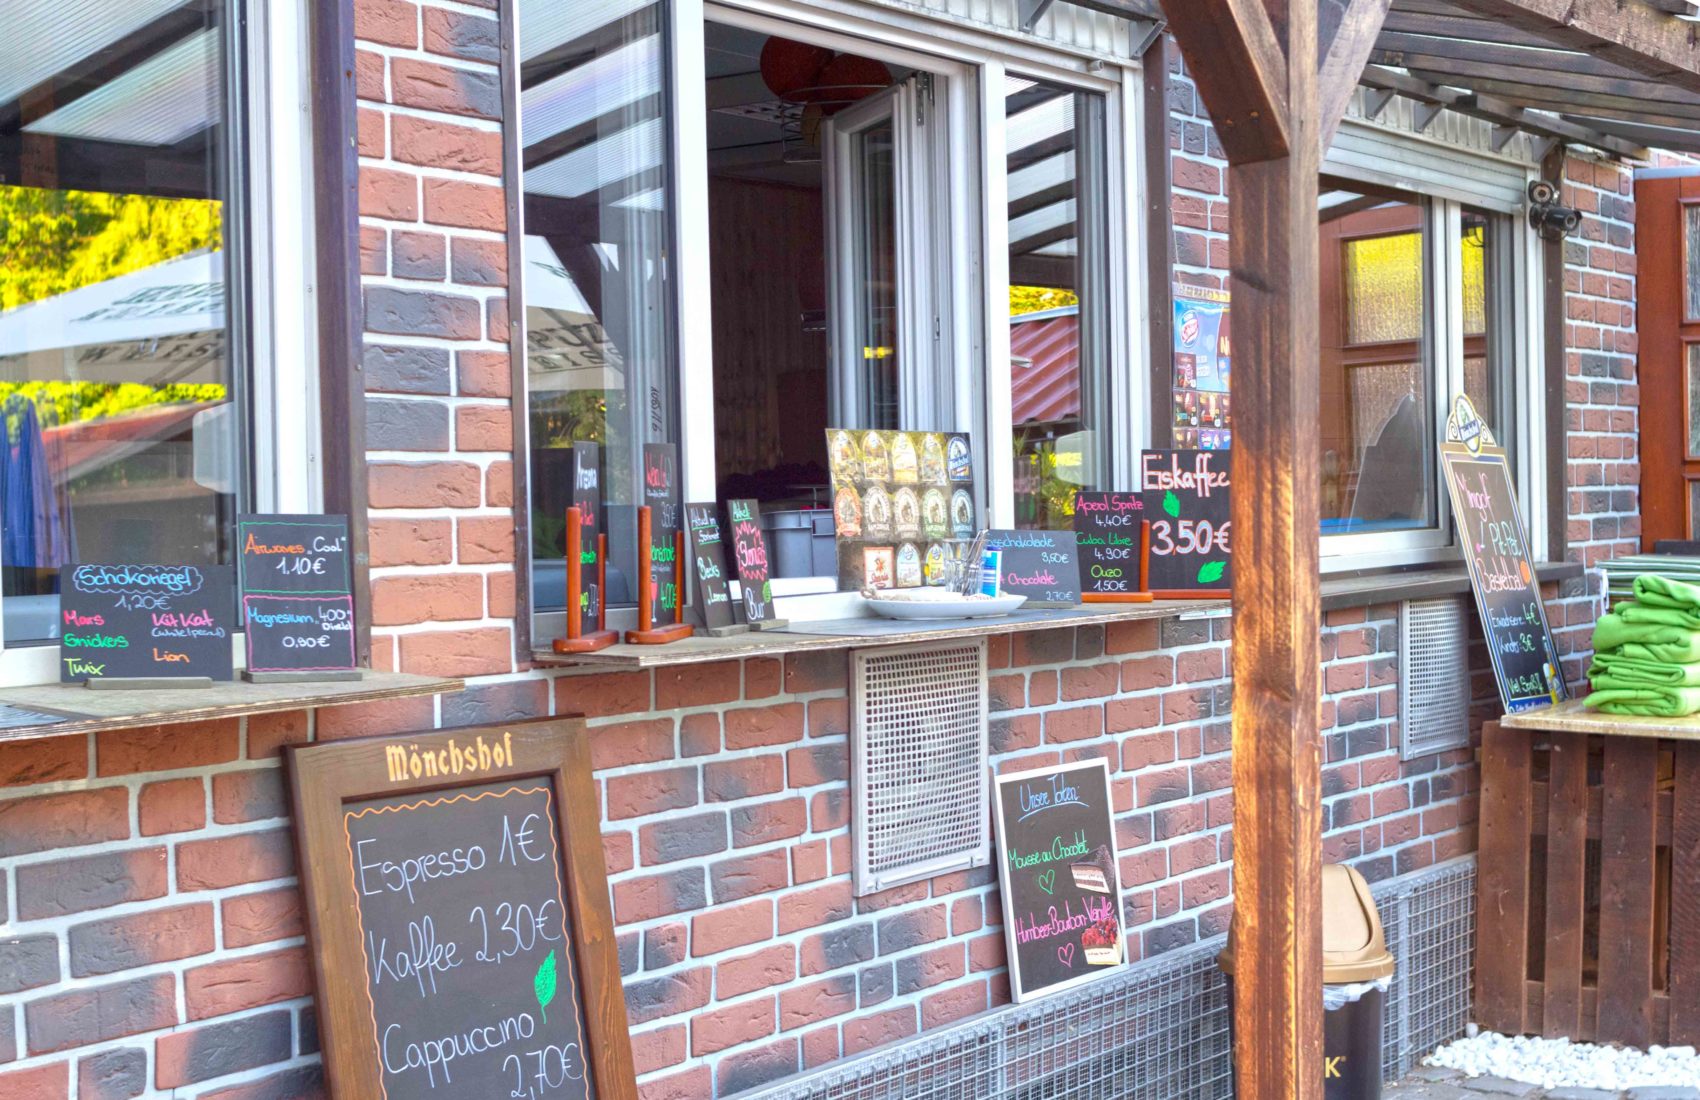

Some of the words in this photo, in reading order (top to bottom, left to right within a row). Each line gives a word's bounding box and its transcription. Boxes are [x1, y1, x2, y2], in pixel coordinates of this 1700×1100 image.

[1143, 452, 1231, 497] Eiskaffee
[1077, 494, 1110, 516] Aperol
[1112, 495, 1144, 515] Spritz
[244, 533, 305, 556] Airwaves
[1075, 532, 1106, 545] Cuba
[1151, 520, 1232, 555] 3,50€
[78, 568, 192, 592] Schokoriegel
[1007, 569, 1059, 586] Chocolate
[1091, 564, 1122, 578] Ouzo
[1475, 556, 1528, 594] Basketball
[114, 595, 173, 611] 1,20€
[63, 610, 105, 628] Mars
[247, 606, 314, 628] Magnesium
[63, 633, 129, 649] Snickers
[64, 657, 106, 677] Twix
[152, 648, 191, 664] Lion
[385, 732, 514, 782] Mönchshof
[357, 838, 486, 904] Espresso
[499, 814, 546, 866] 1€
[1007, 847, 1042, 872] Mousse
[369, 915, 463, 998] Kaffee
[469, 899, 561, 964] 2,30€
[383, 1012, 535, 1089] Cappuccino
[502, 1043, 583, 1100] 2,70€
